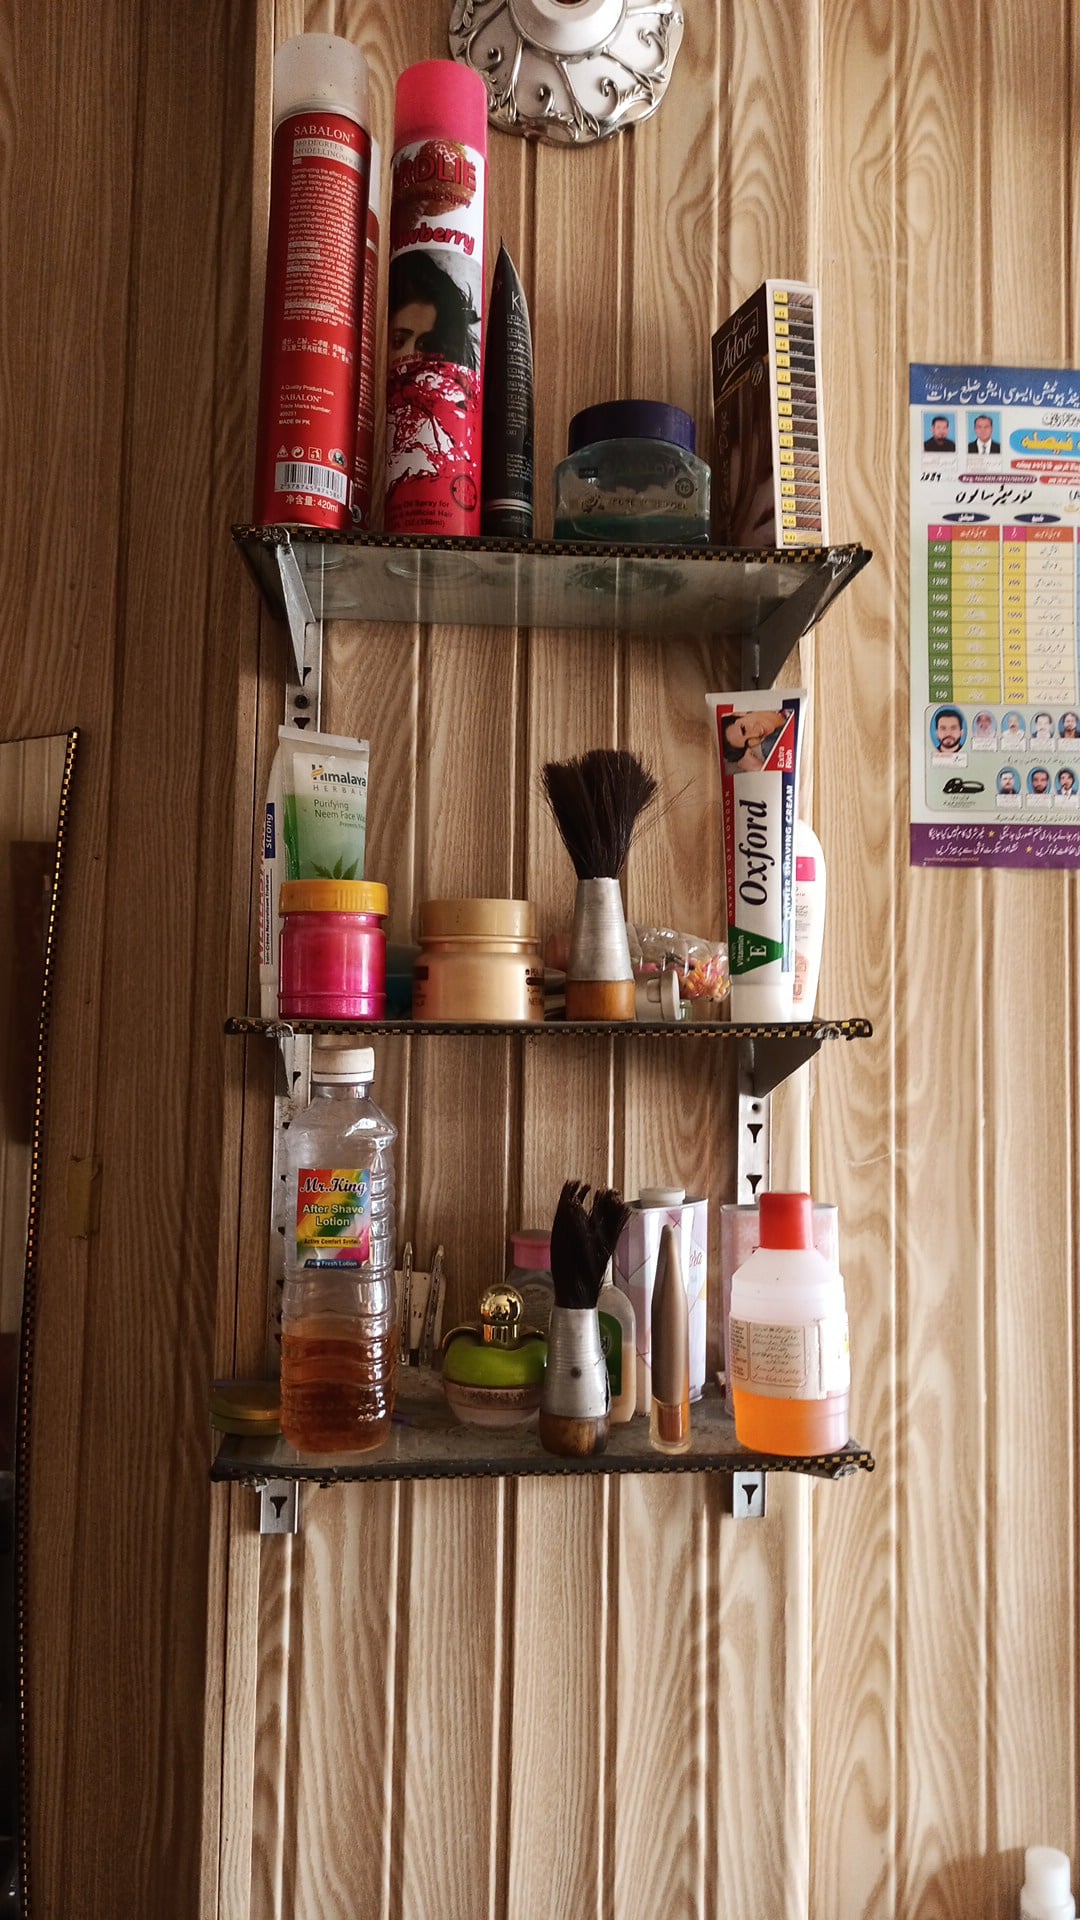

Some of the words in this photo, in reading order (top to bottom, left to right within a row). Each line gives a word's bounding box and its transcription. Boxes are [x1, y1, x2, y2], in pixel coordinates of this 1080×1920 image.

[294, 125, 350, 143] SABALON
[785, 749, 793, 768] Rich
[313, 784, 367, 796] HERBAL
[314, 799, 349, 811] Purifying
[785, 784, 793, 823] CREAM
[314, 810, 338, 818] Neem
[340, 811, 356, 820] Face
[739, 799, 775, 906] Oxford
[785, 826, 793, 872] SHAVING
[301, 1178, 366, 1198] Mr.King
[303, 1204, 328, 1213] After
[332, 1204, 364, 1213] Shave
[316, 1217, 350, 1226] Lotion
